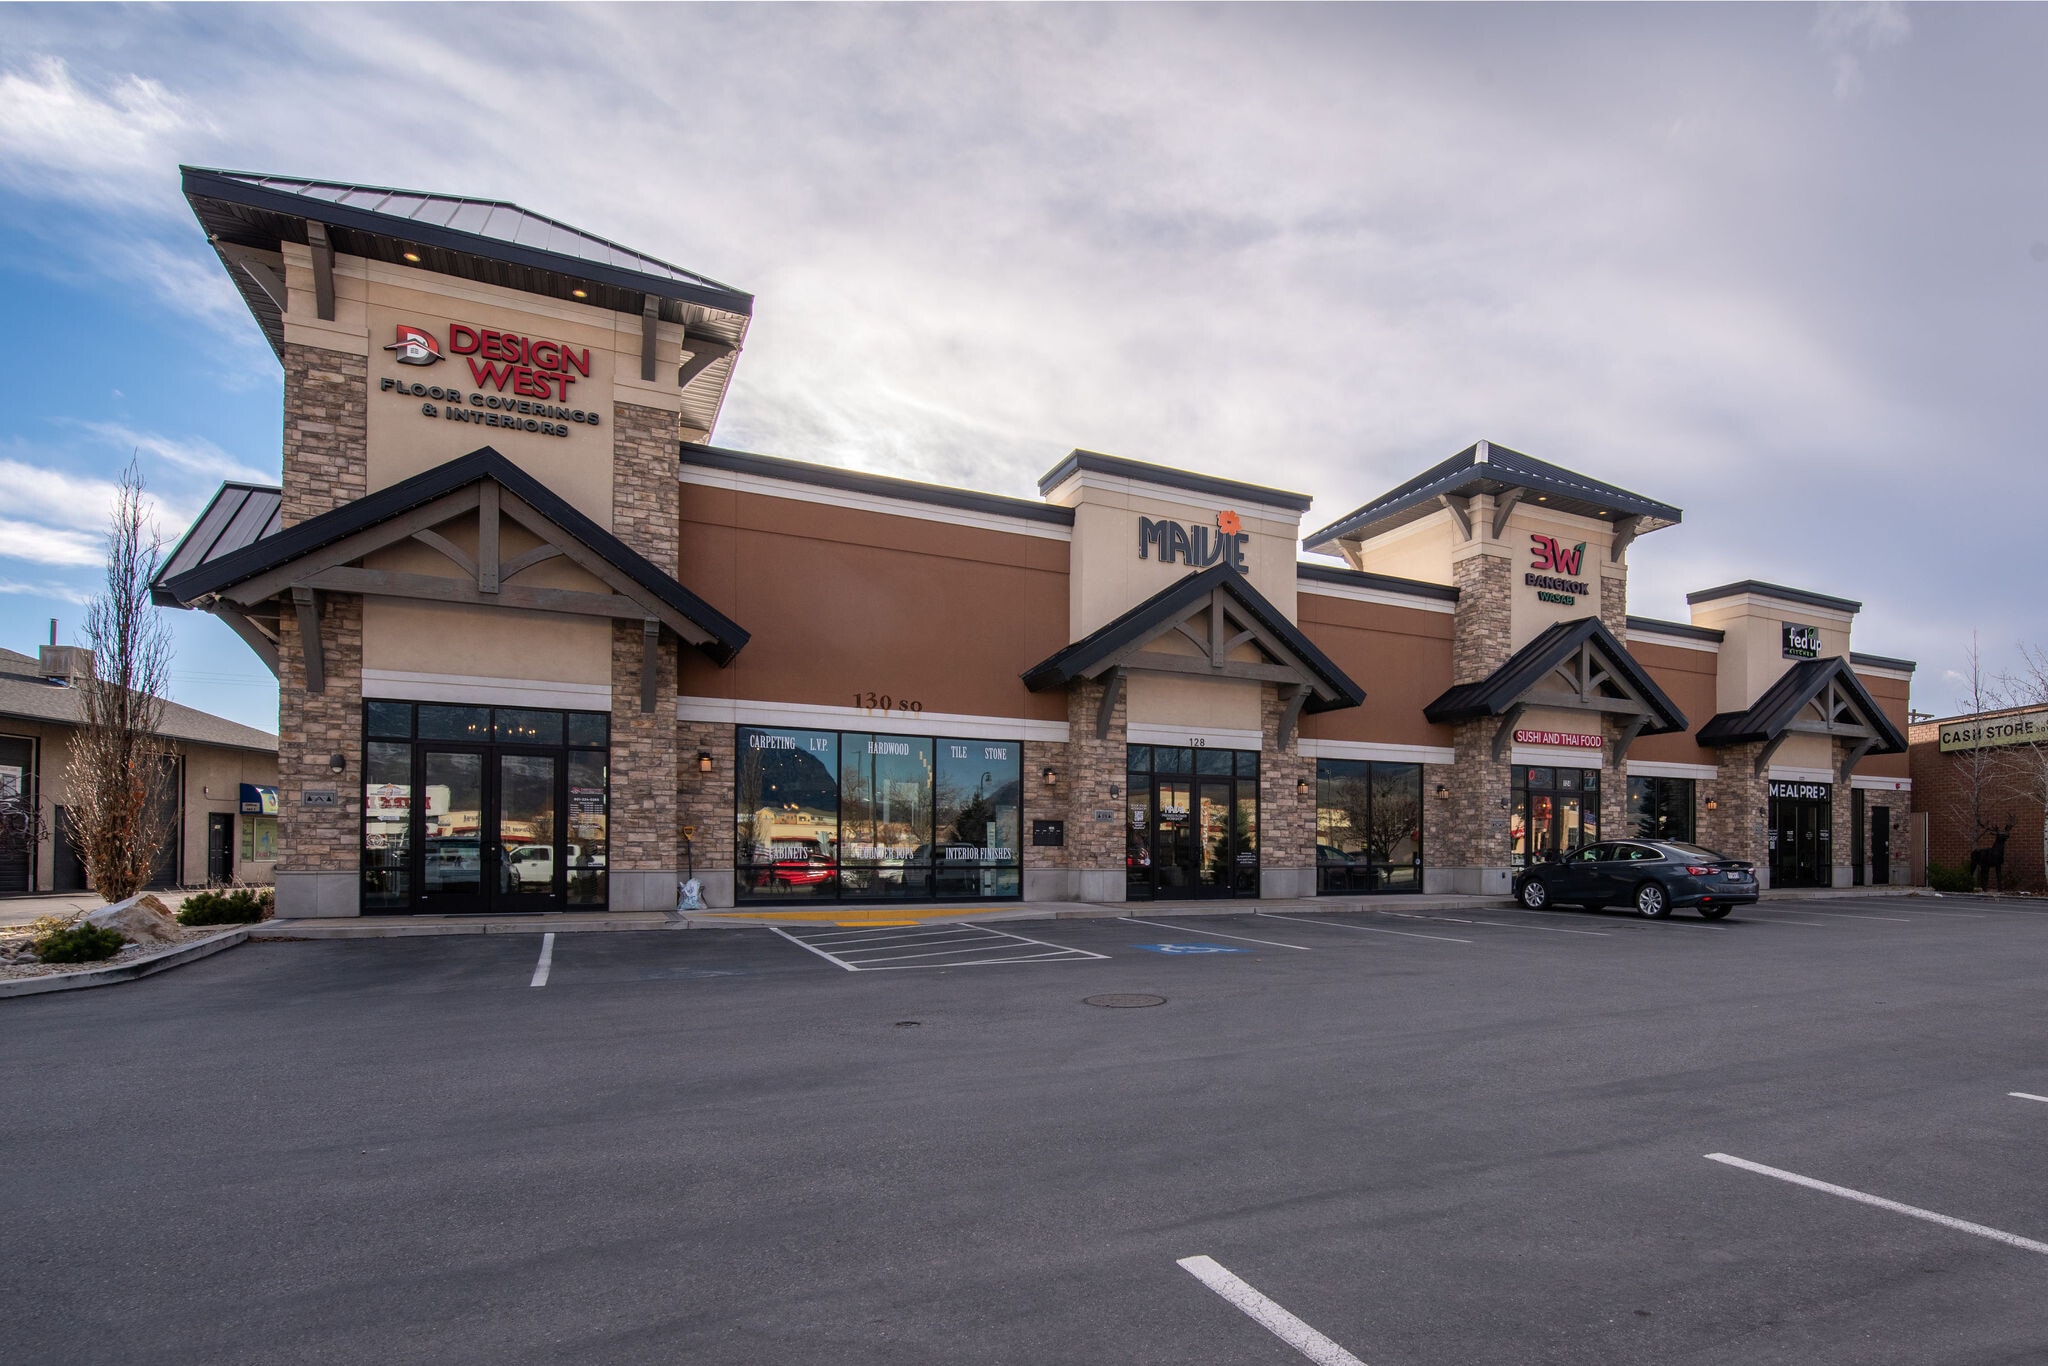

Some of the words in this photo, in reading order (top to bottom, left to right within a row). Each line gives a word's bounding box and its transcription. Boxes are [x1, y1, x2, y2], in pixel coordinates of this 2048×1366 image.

[450, 323, 590, 377] DESIGN
[466, 357, 576, 402] WEST
[380, 377, 462, 403] FLOOR
[468, 392, 600, 425] COVERINGS
[422, 403, 437, 418] &
[446, 406, 568, 437] INTERIORS
[1525, 573, 1589, 595] BANGKOK
[1789, 627, 1808, 650] fed
[1810, 638, 1822, 657] up
[852, 691, 892, 710] 130
[749, 734, 796, 750] CARPETING
[1189, 737, 1205, 747] 128
[1517, 730, 1541, 743] SUSHI
[1542, 734, 1560, 744] AND
[1561, 734, 1580, 746] THAI
[1580, 735, 1602, 747] FOOD
[1942, 728, 1981, 744] CASH
[1986, 722, 2033, 739] STORE
[867, 741, 909, 756] HARDWOOD
[950, 745, 968, 758] TILE
[984, 747, 1007, 760] STONE
[1769, 783, 1799, 798] MEAL
[768, 846, 808, 860] CABINETS
[945, 847, 979, 860] INTERIOR
[980, 847, 1012, 860] FINISHES
